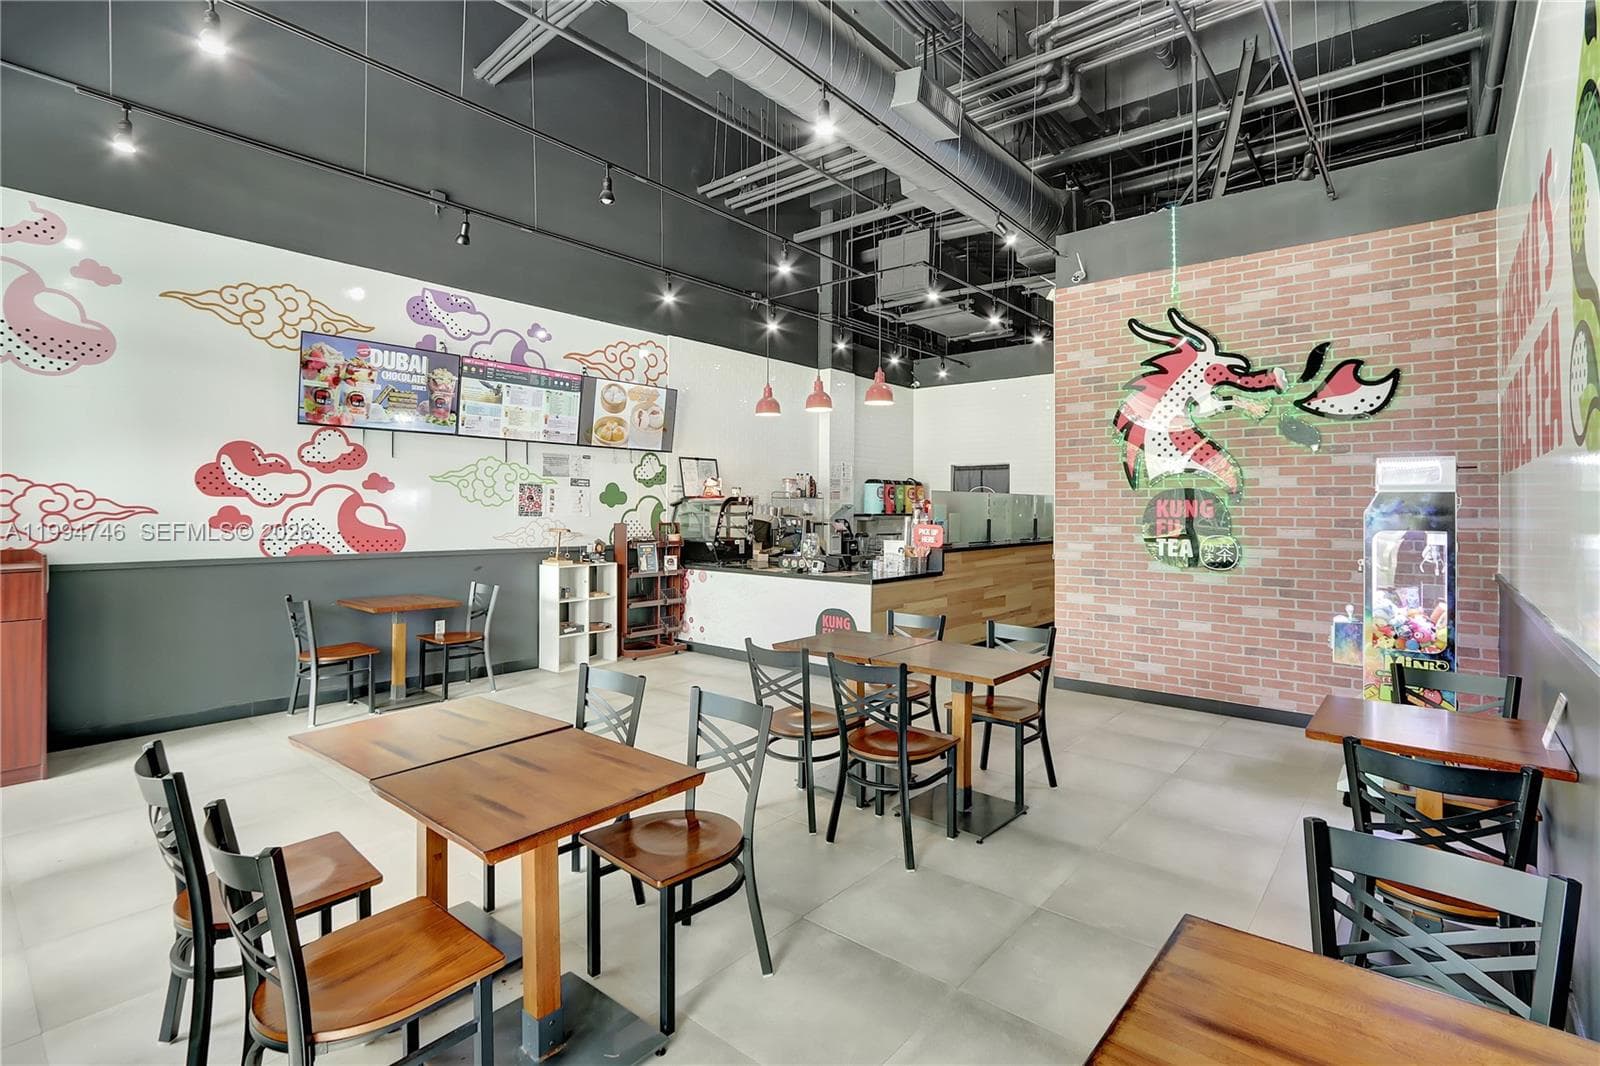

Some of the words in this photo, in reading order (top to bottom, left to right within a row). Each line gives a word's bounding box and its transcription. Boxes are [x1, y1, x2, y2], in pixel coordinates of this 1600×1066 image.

[370, 348, 429, 375] DUBAI
[381, 370, 427, 385] CHOCOLATE
[1534, 307, 1563, 458] TEA
[1156, 499, 1215, 518] KUNG
[1156, 538, 1194, 558] TEA
[822, 614, 851, 630] KUNG
